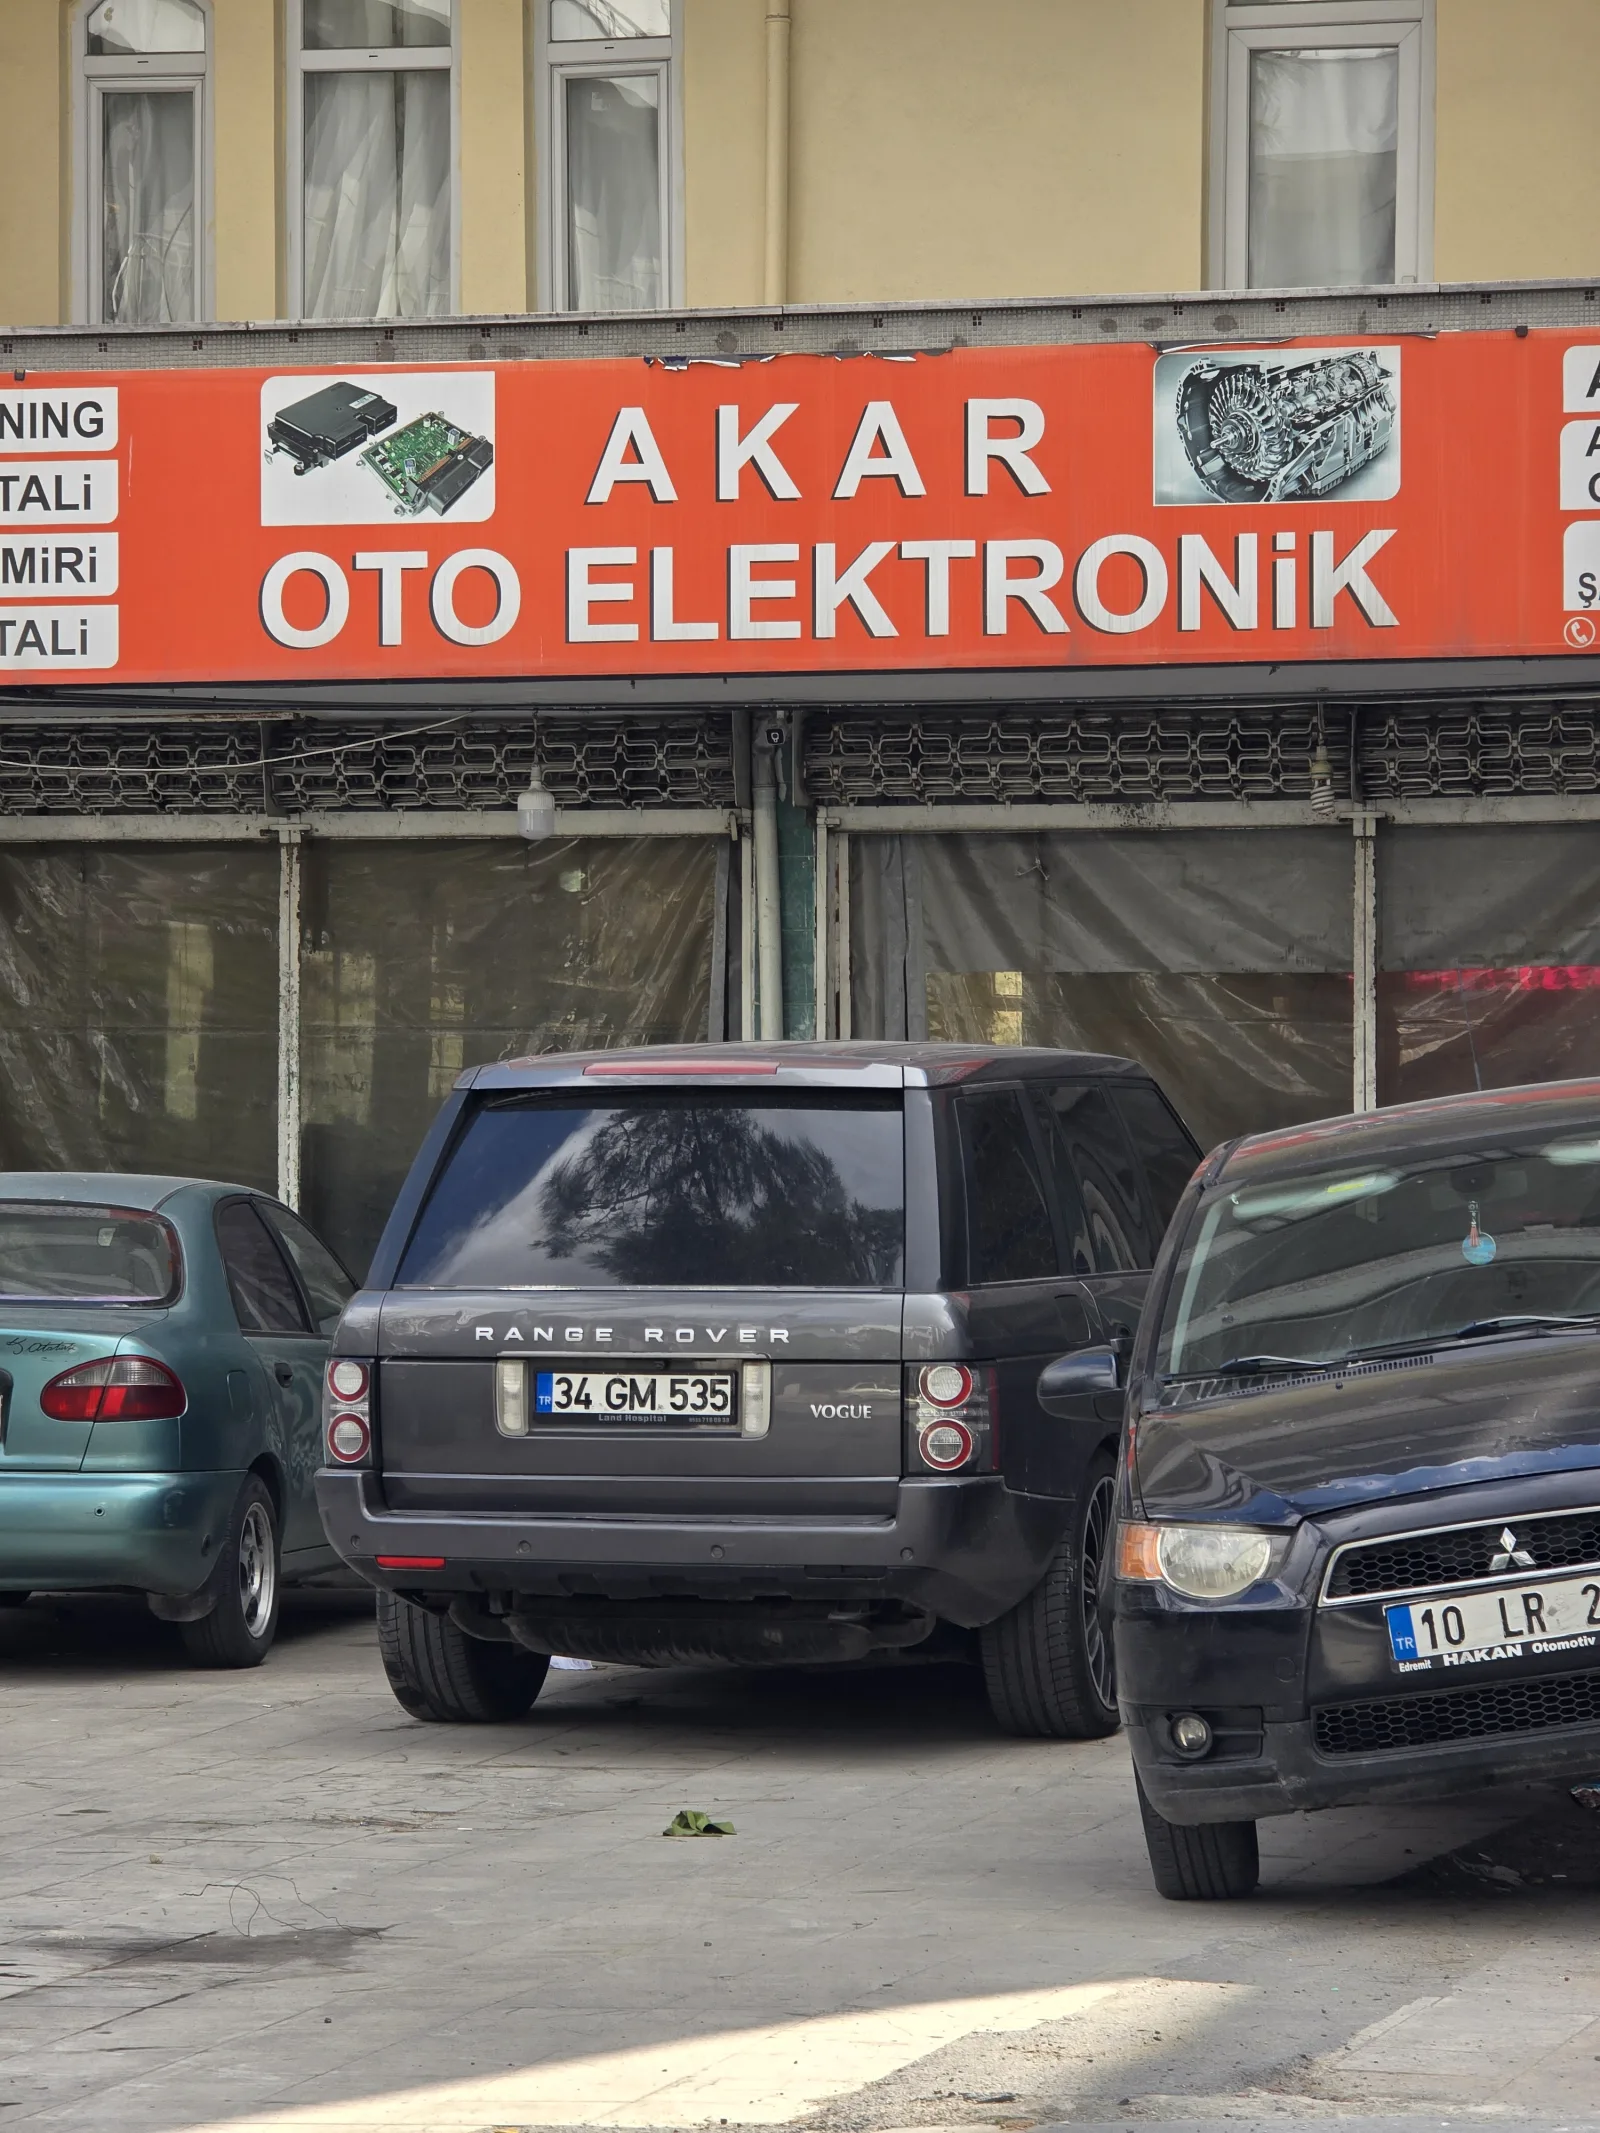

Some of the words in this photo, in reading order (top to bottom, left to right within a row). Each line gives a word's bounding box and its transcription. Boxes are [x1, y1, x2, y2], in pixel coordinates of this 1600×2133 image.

[0, 400, 104, 440] NING
[584, 398, 1052, 505] AKAR
[258, 547, 522, 650] OTO
[566, 528, 1400, 643] ELEKTRONiK
[475, 1326, 613, 1343] RANGE
[644, 1327, 790, 1344] ROVER
[538, 1396, 552, 1406] TR
[554, 1376, 592, 1410] 34
[605, 1377, 657, 1411] GM
[669, 1378, 729, 1412] 535
[810, 1404, 872, 1419] VOGUE
[598, 1413, 622, 1422] Land
[625, 1414, 667, 1424] Hospital
[1395, 1636, 1415, 1650] TR
[1421, 1605, 1465, 1650] 10
[1498, 1592, 1548, 1639] LR
[1399, 1659, 1432, 1672] Edremit
[1442, 1644, 1523, 1667] HAKAN
[1531, 1635, 1596, 1654] Otomotiv
